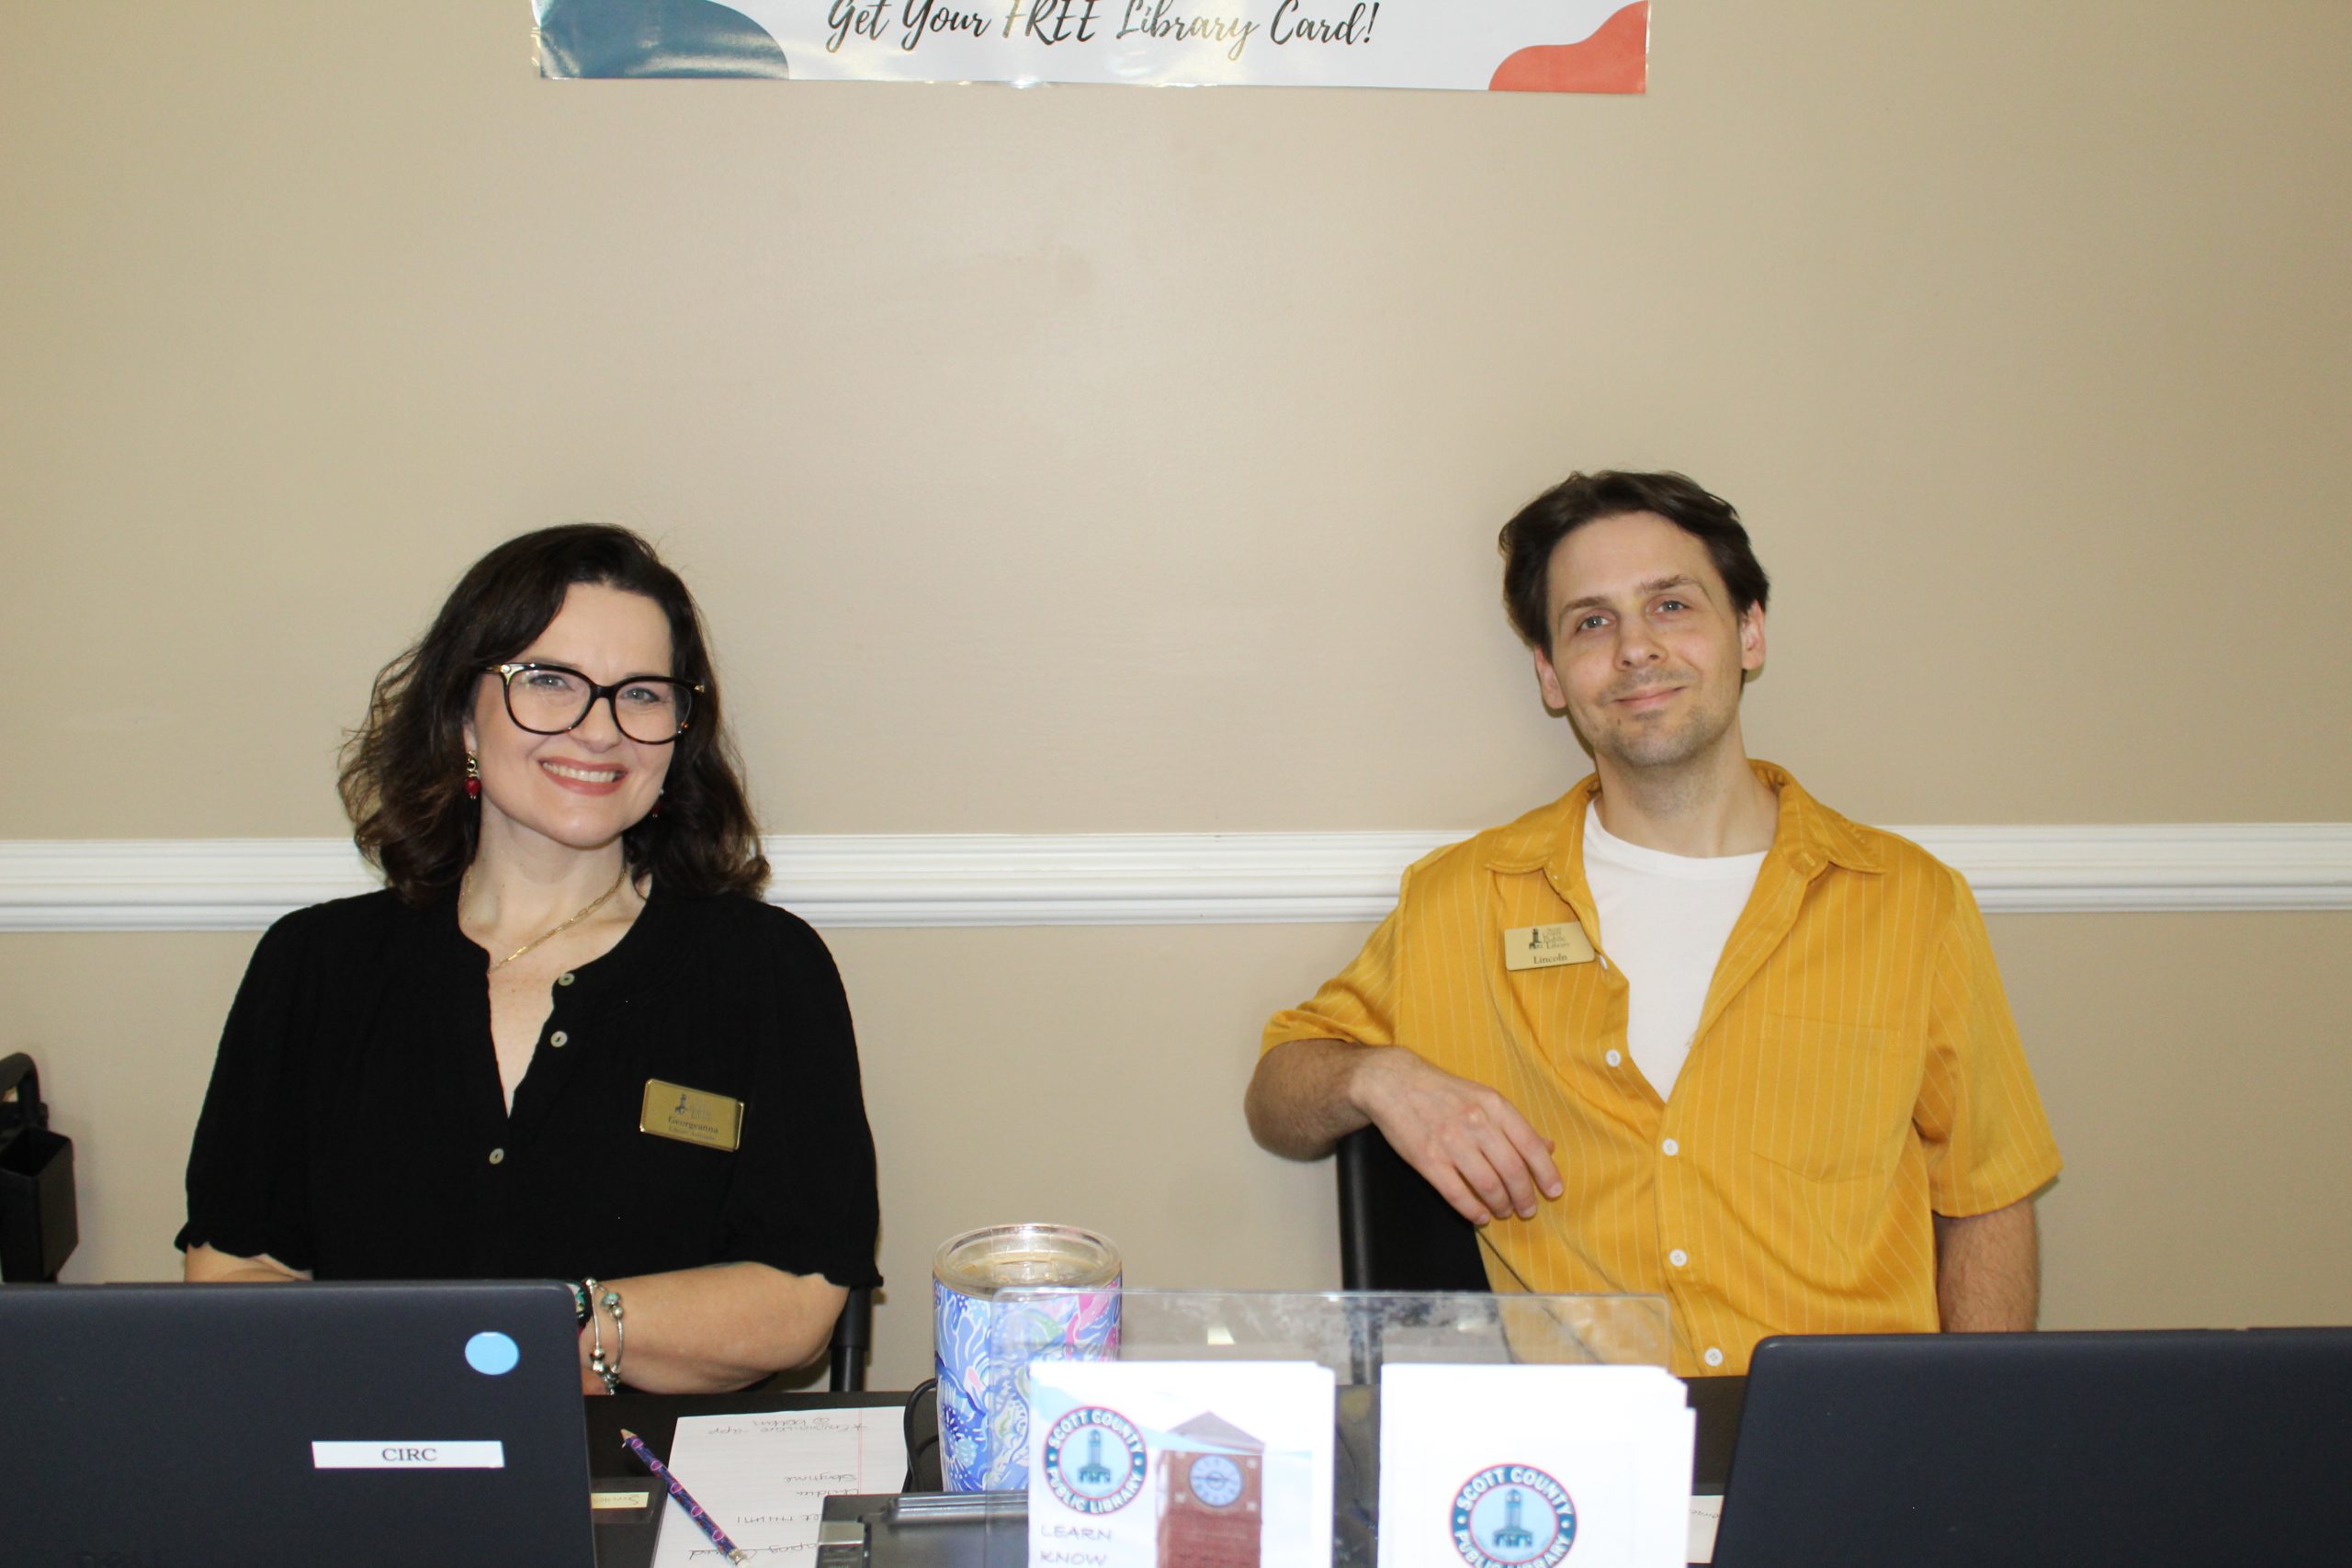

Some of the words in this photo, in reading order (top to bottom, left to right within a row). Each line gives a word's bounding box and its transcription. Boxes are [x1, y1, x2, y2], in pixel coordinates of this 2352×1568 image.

[826, 0, 892, 53] Get
[901, 0, 991, 51] Your
[1001, 0, 1102, 45] FREE
[1115, 0, 1260, 61] Library
[1270, 0, 1379, 45] Card!
[1533, 953, 1567, 964] Lincoln
[1048, 1410, 1089, 1450] SCOTT
[1091, 1409, 1143, 1452] COUNTY
[381, 1448, 437, 1461] CIRC
[1047, 1467, 1088, 1512] PUBLIC
[1090, 1470, 1143, 1514] LIBRARY
[1456, 1469, 1506, 1511] SCOTT
[1510, 1467, 1574, 1515] COUNTY
[1041, 1525, 1112, 1540] LEARN
[1040, 1550, 1107, 1566] KNOW
